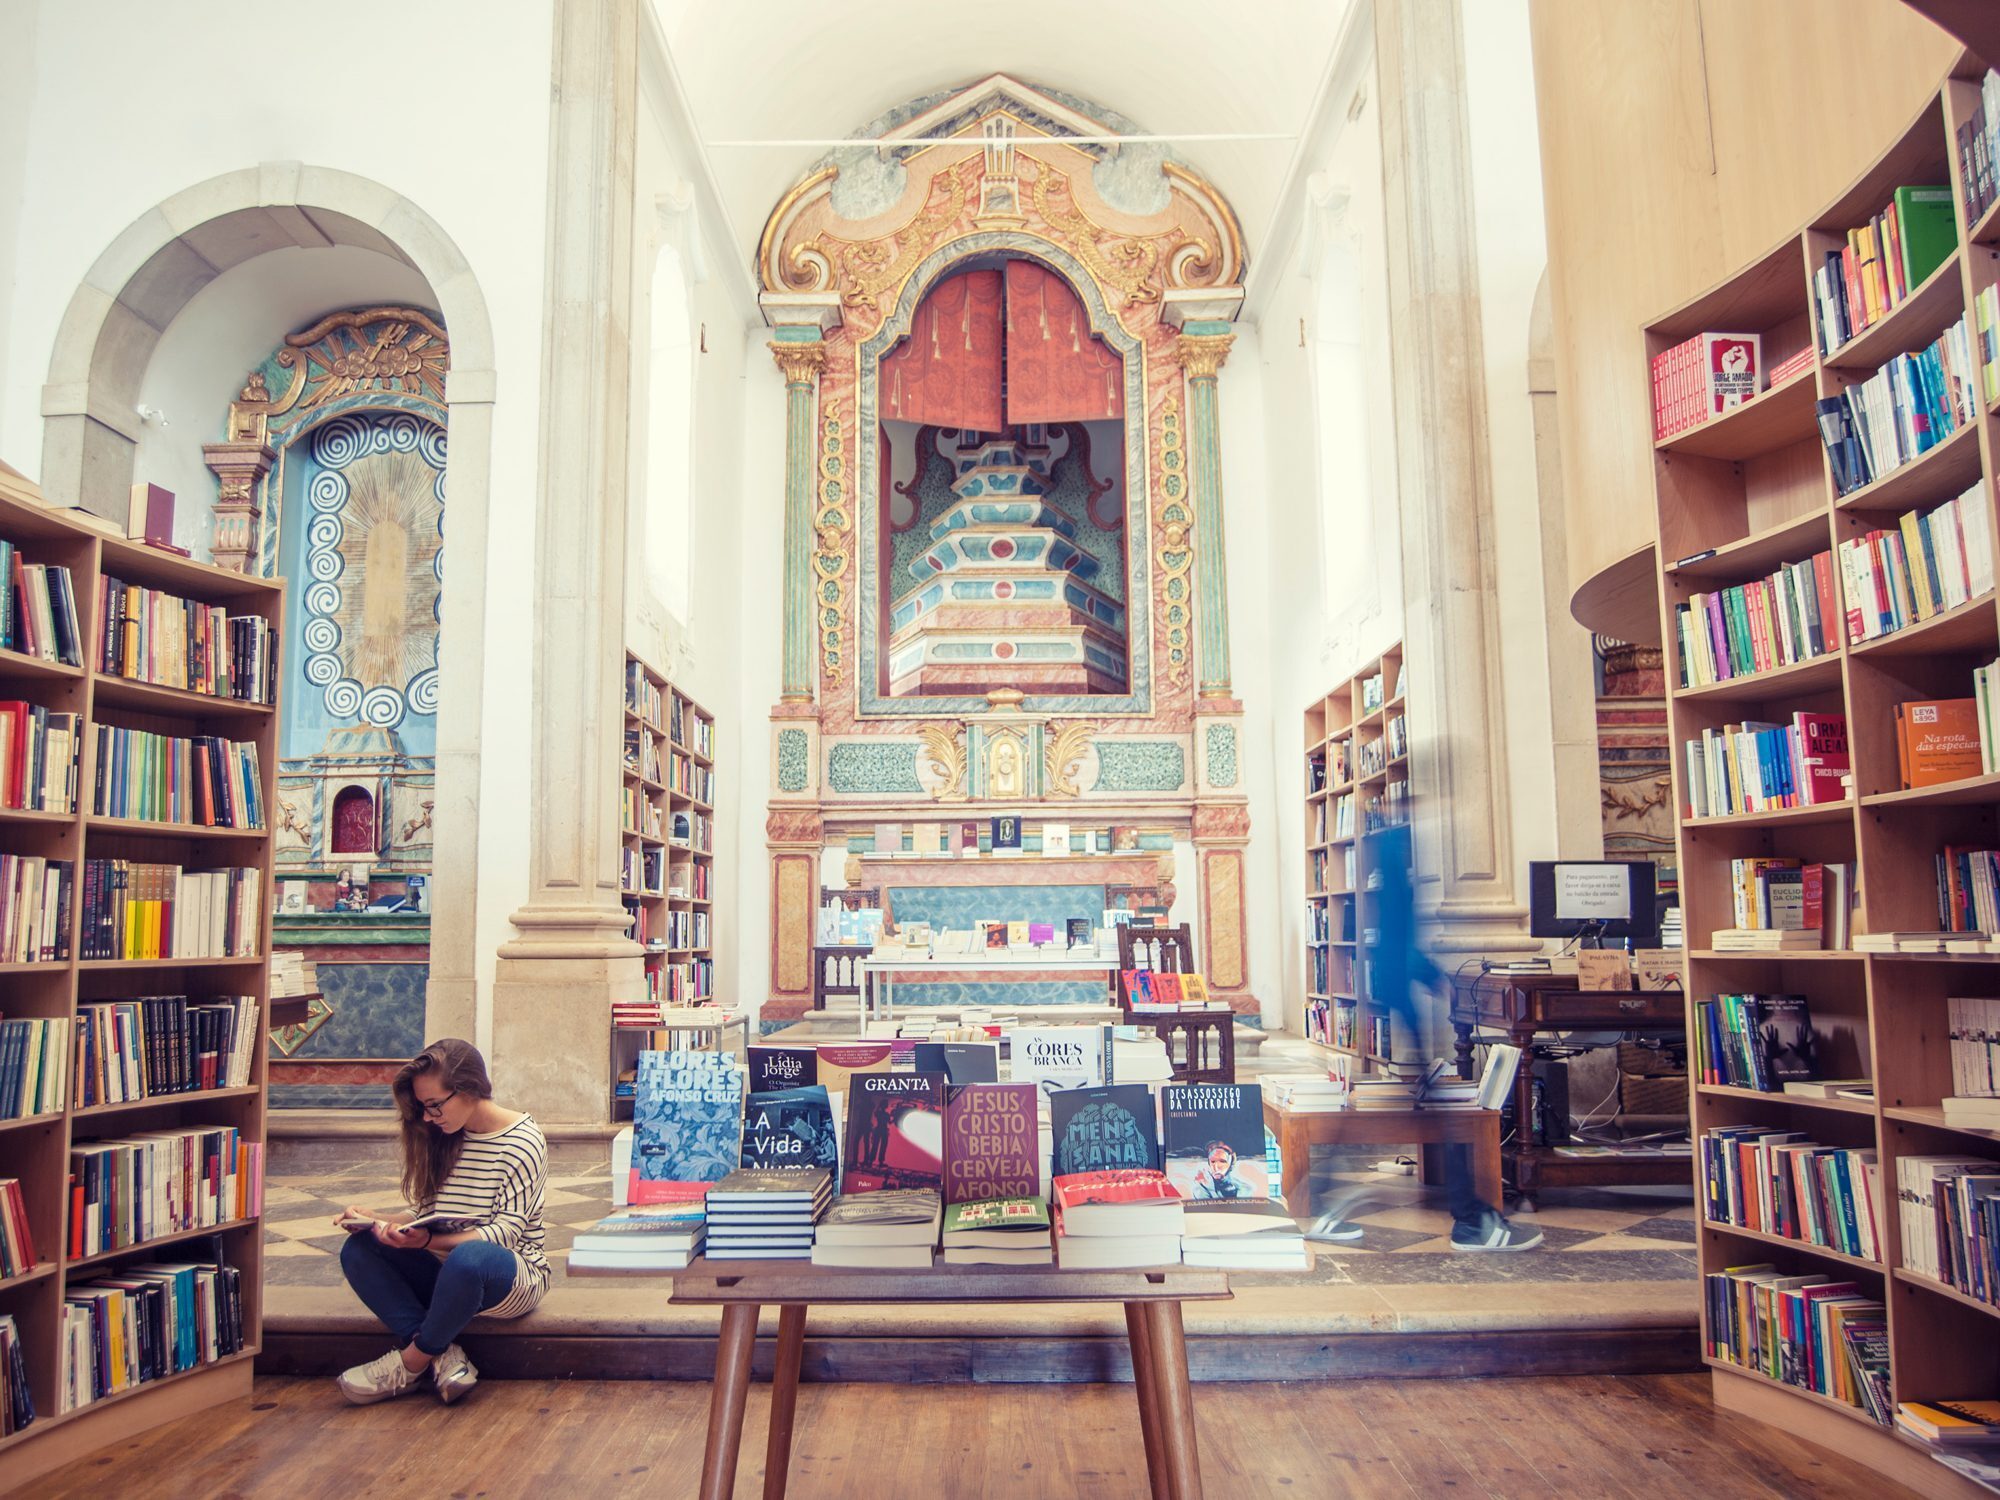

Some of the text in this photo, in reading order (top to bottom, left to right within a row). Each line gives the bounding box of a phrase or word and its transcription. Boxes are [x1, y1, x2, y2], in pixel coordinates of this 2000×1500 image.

[1914, 708, 1935, 716] LEYA
[1924, 733, 1966, 743] Na rota
[1916, 742, 1934, 752] das
[1027, 1043, 1083, 1056] CORES
[643, 1051, 736, 1070] FLORES
[769, 1055, 802, 1069] Lídia
[1034, 1056, 1083, 1066] BRANCA
[650, 1069, 742, 1090] FLORES
[762, 1064, 800, 1079] Jorge
[865, 1078, 930, 1091] GRANTA
[649, 1090, 740, 1103] AFONSO CRUZ
[1170, 1087, 1241, 1100] DESASSOSSEGO
[963, 1092, 1020, 1113] JESUS
[1170, 1099, 1241, 1110] DA LIBERDADE
[755, 1111, 771, 1130] A
[958, 1114, 1026, 1134] CRISTO
[1069, 1119, 1135, 1141] MENS
[754, 1135, 802, 1154] Vida
[969, 1135, 1023, 1156] BEBIA
[1073, 1143, 1138, 1164] SANA
[951, 1157, 1035, 1178] CERVEJA
[955, 1181, 1030, 1199] AFONSO
